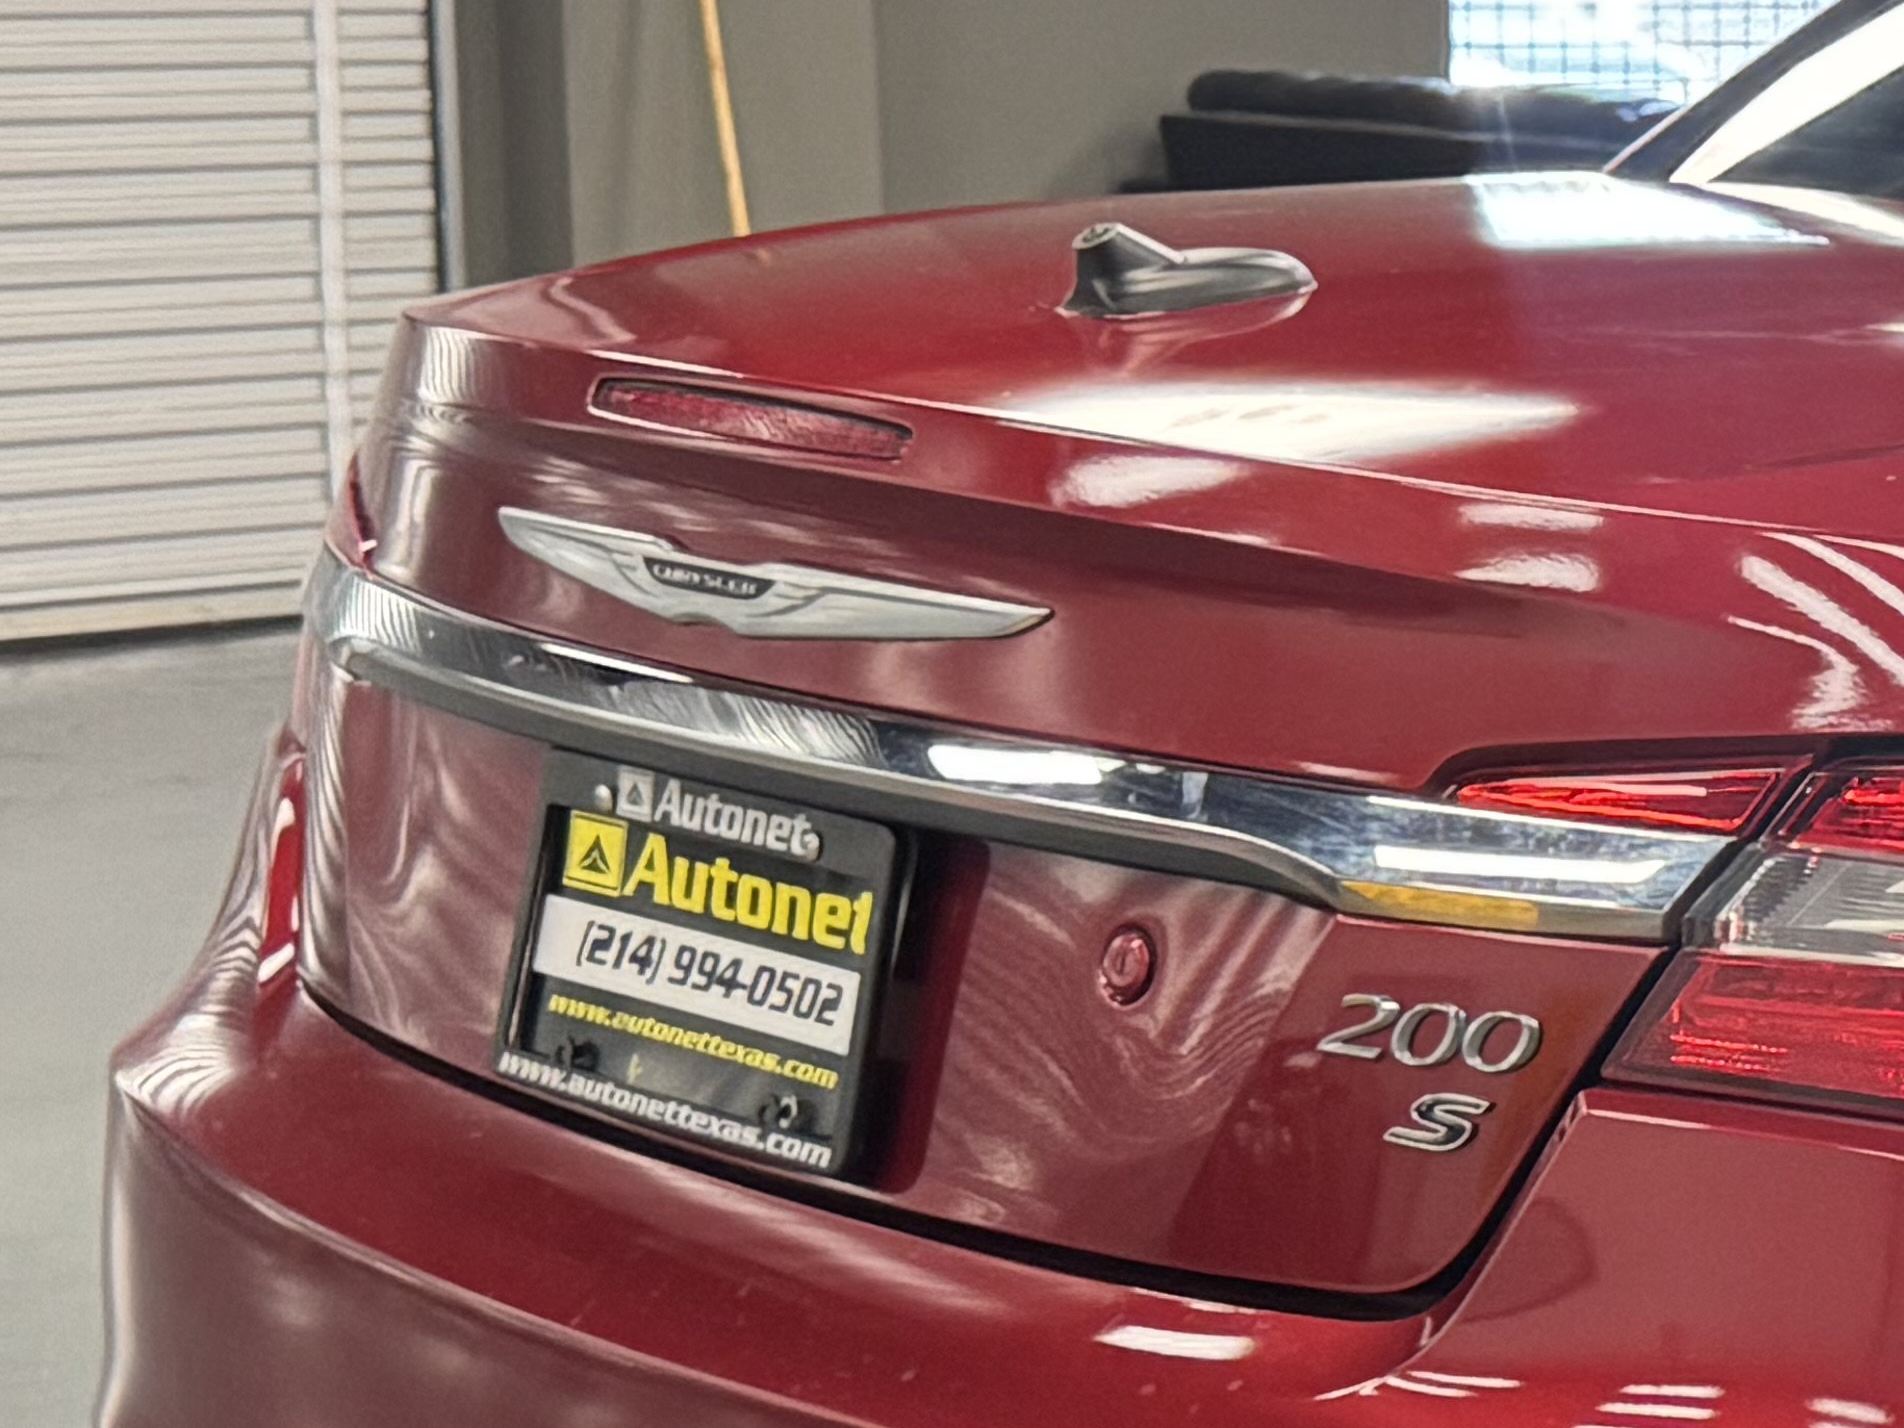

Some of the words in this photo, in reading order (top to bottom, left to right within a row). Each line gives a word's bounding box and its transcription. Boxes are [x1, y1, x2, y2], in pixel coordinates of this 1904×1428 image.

[654, 779, 811, 855] Autonet
[622, 832, 874, 955] Autonet
[575, 918, 667, 986] (214)
[666, 944, 844, 1028] 994-0502
[547, 993, 840, 1091] www.autonettexas.com
[1316, 992, 1541, 1073] 200
[499, 1050, 833, 1169] www.autonettexas.com
[1382, 1091, 1491, 1152] S
